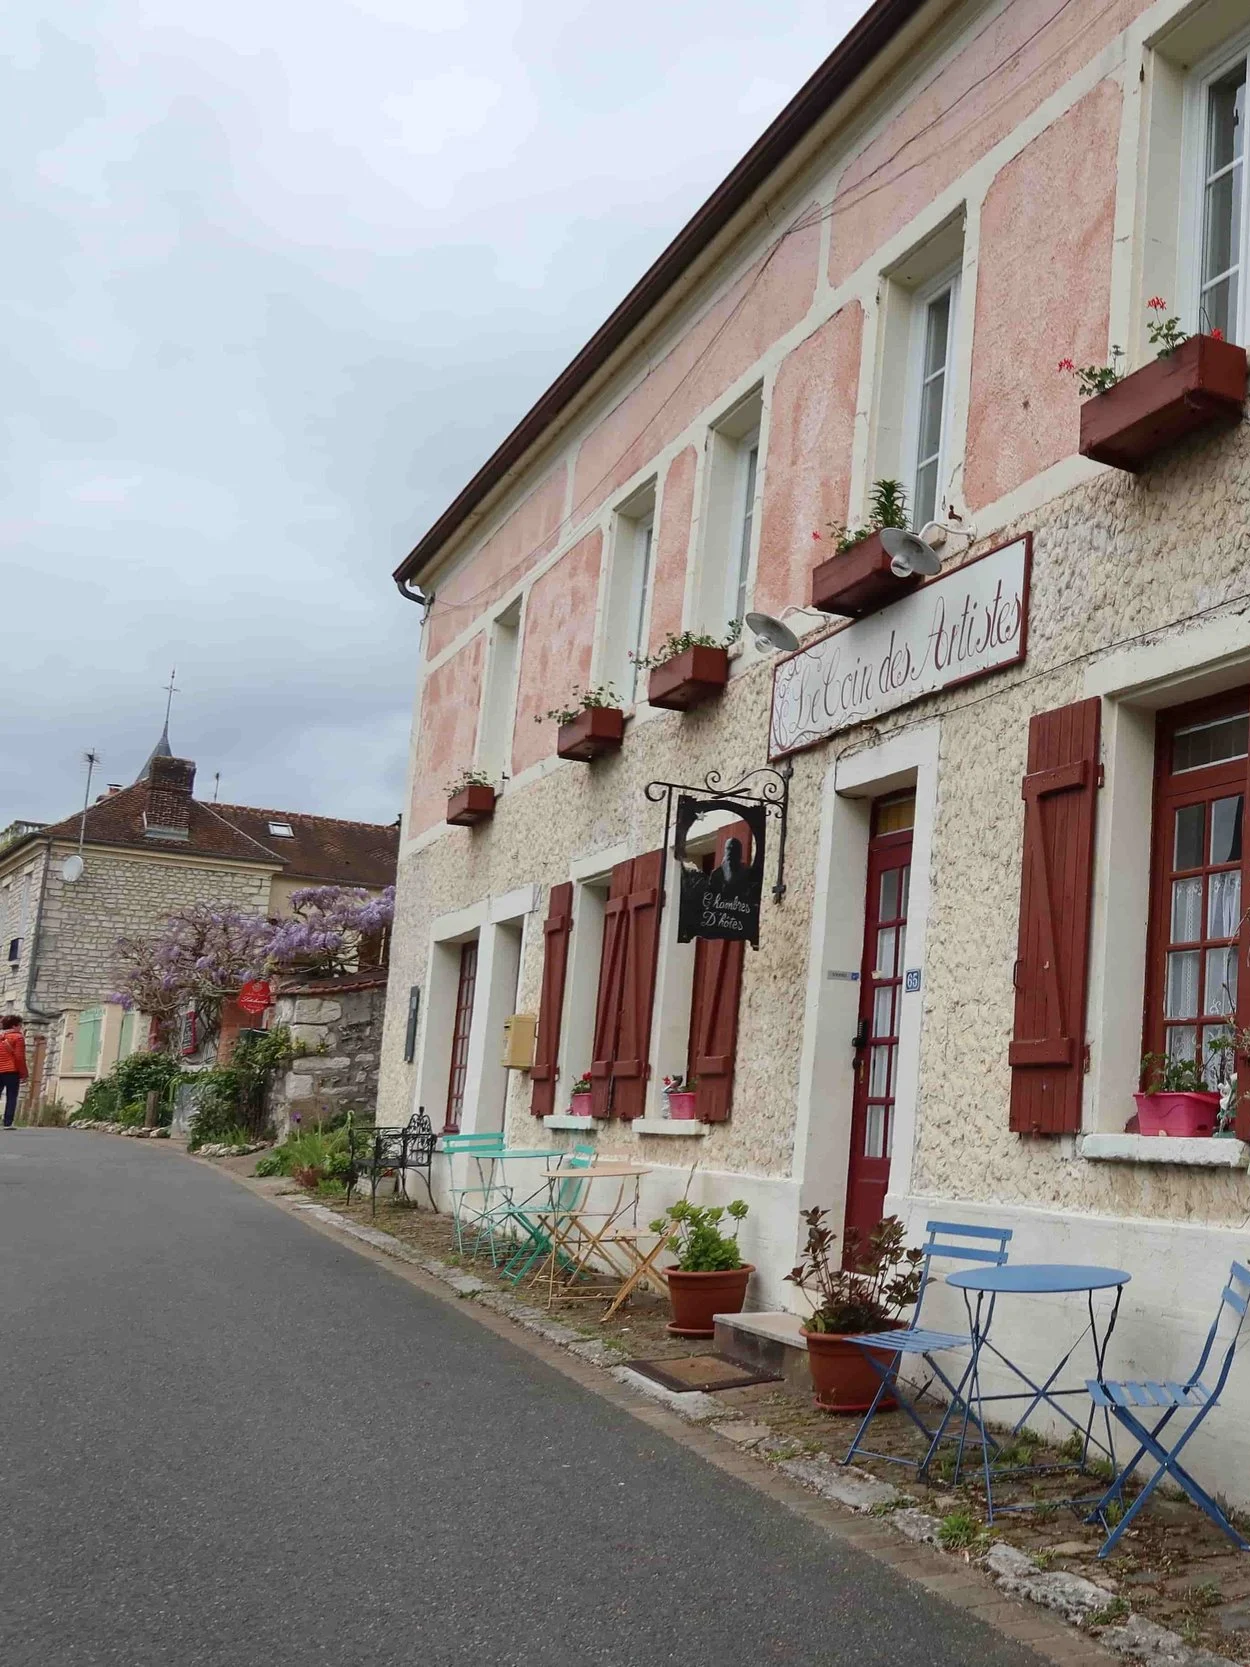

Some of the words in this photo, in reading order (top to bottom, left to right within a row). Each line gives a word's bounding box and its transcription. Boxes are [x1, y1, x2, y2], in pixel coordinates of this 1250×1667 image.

[878, 629, 911, 693] des
[911, 579, 1021, 680] Artistes
[702, 891, 751, 914] Chambres
[907, 972, 918, 988] 65
